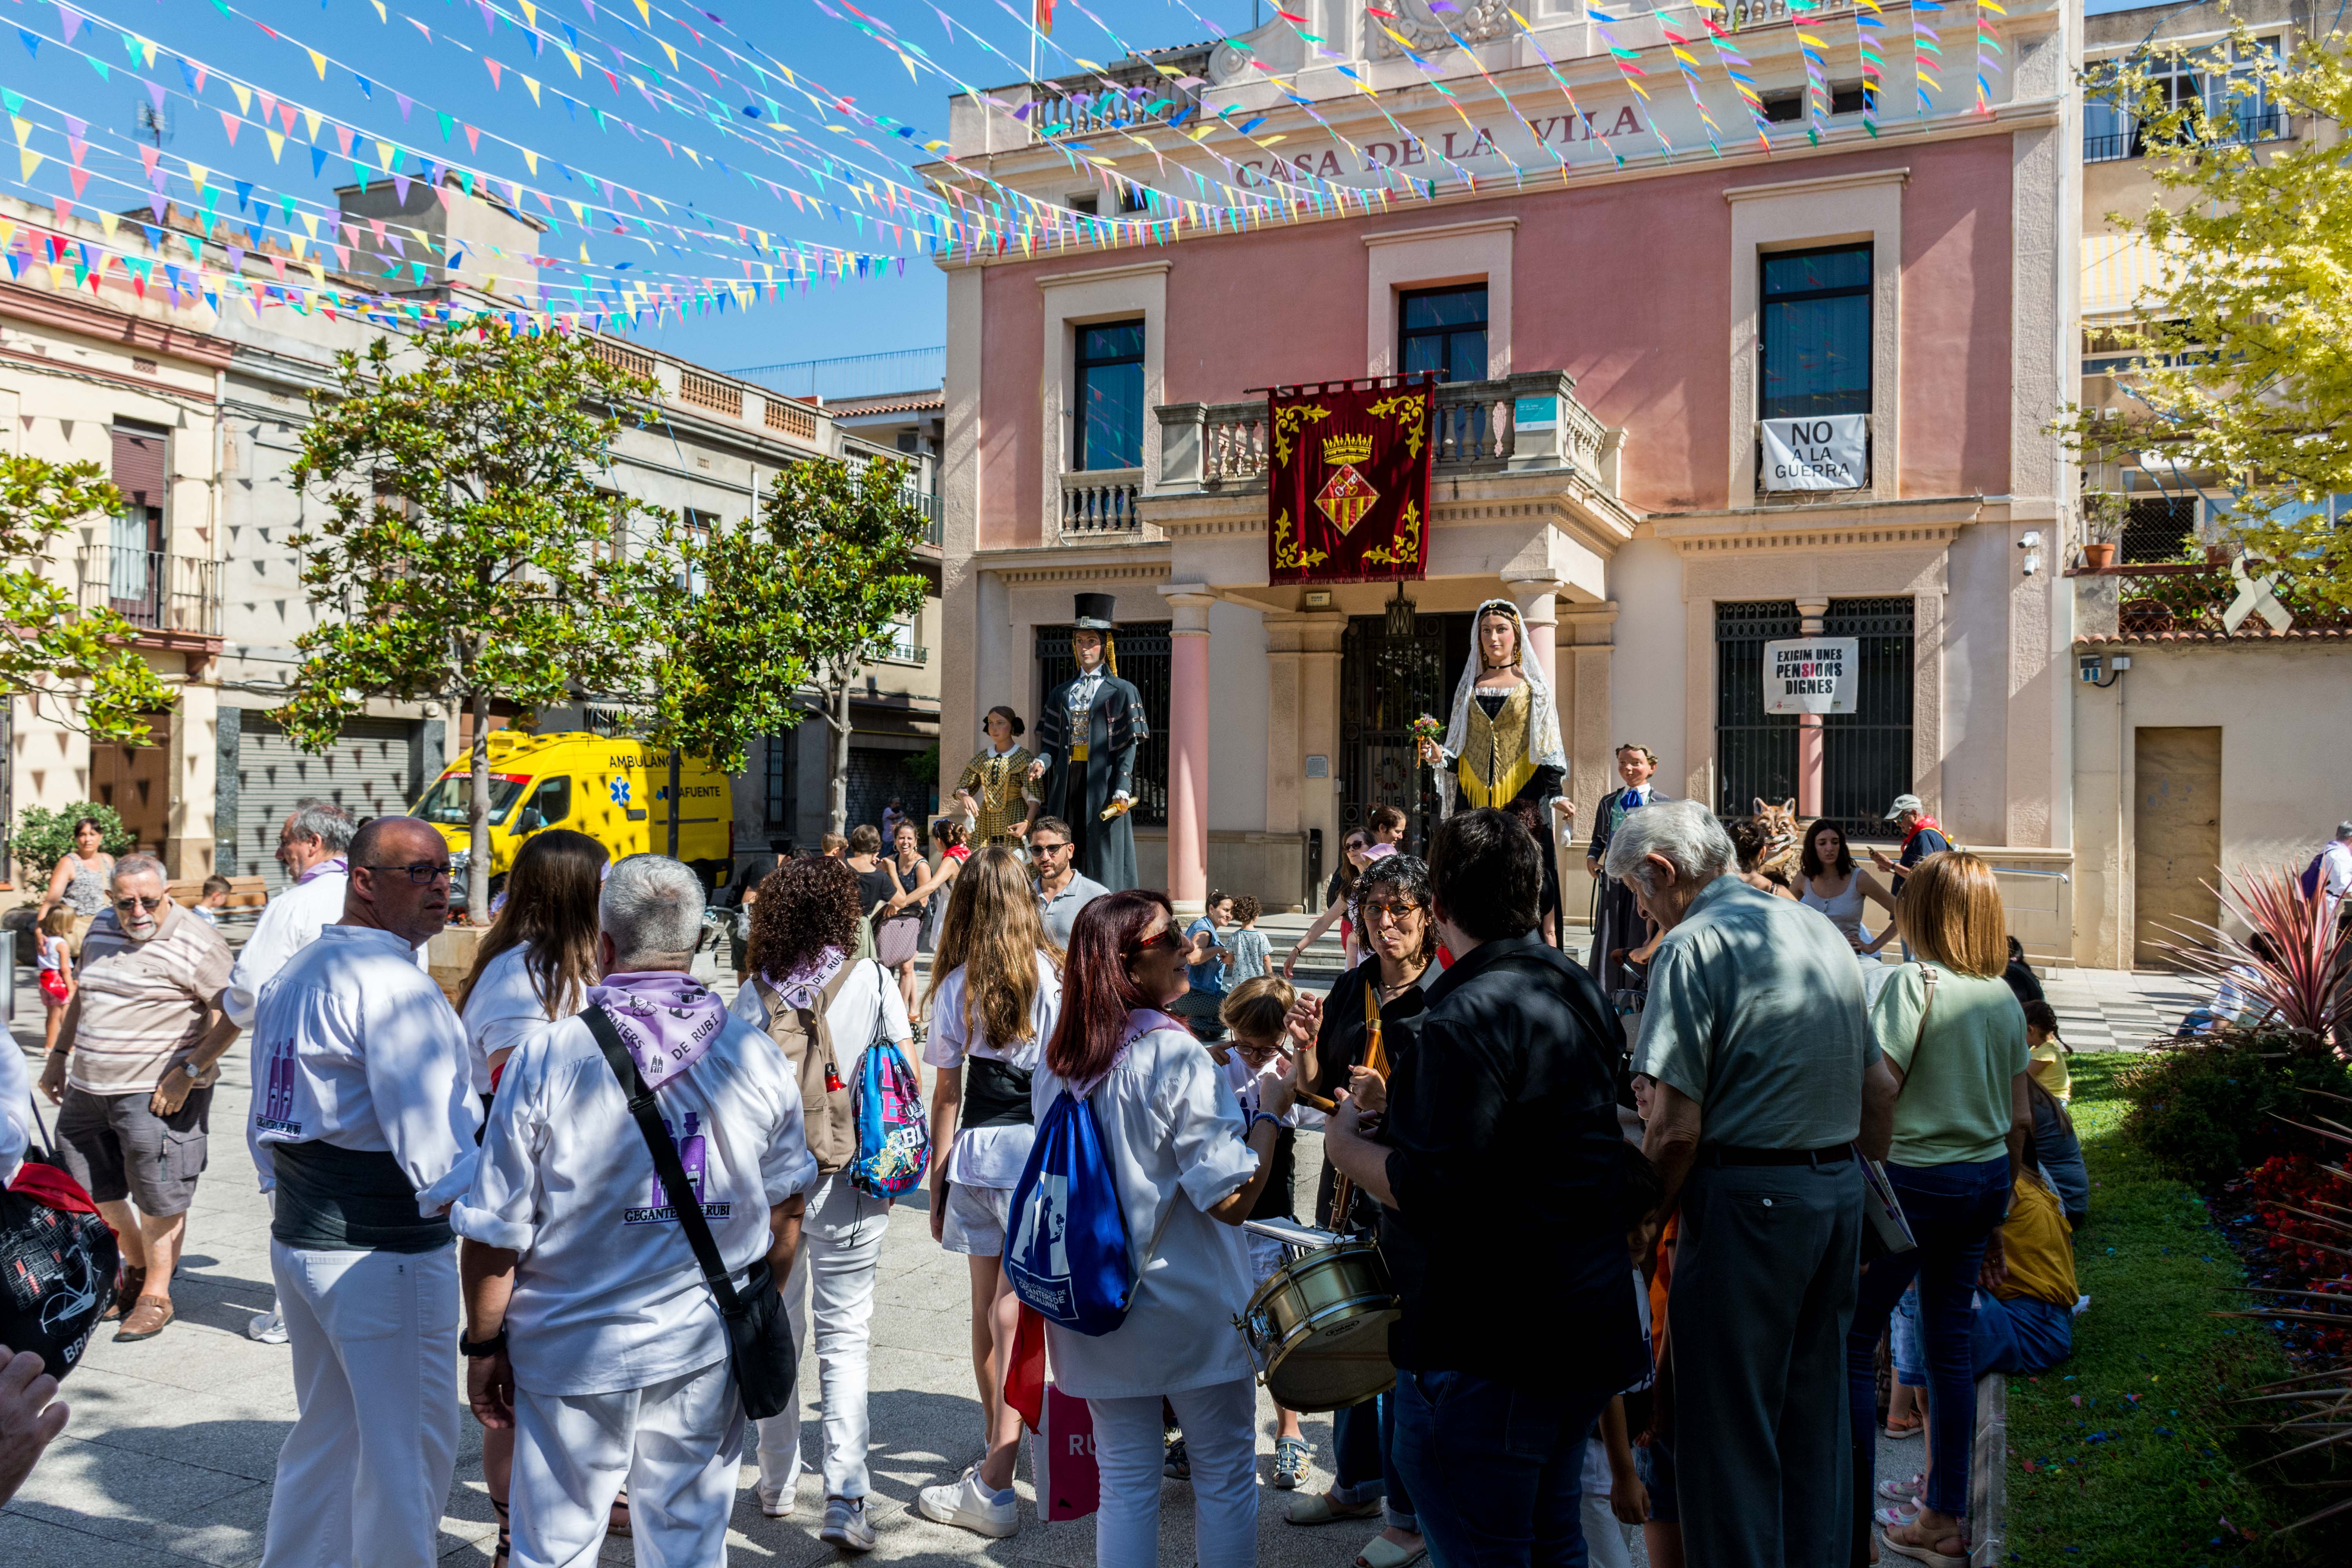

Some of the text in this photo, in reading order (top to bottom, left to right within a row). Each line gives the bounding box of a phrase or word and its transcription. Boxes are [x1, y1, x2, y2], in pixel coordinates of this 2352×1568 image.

[1236, 106, 1643, 188] CASA DE LA VILA
[1791, 421, 1833, 446] NO
[1792, 446, 1832, 461] A LA
[1775, 463, 1850, 478] GUERRA
[1777, 649, 1842, 662] EXIGIM UNES
[1777, 662, 1842, 678] PENSIONS
[1785, 679, 1833, 695] DIGNES
[610, 752, 685, 768] AMBULÀNCA
[679, 786, 720, 797] AFUENTE
[812, 954, 844, 985] DE RUB
[671, 1012, 719, 1061] DE RUBÍ
[624, 1207, 679, 1222] GEGANTE
[706, 1205, 730, 1216] RUBI
[1018, 1281, 1065, 1305] GEGANTERS DE
[1025, 1291, 1060, 1312] CATALUNYA
